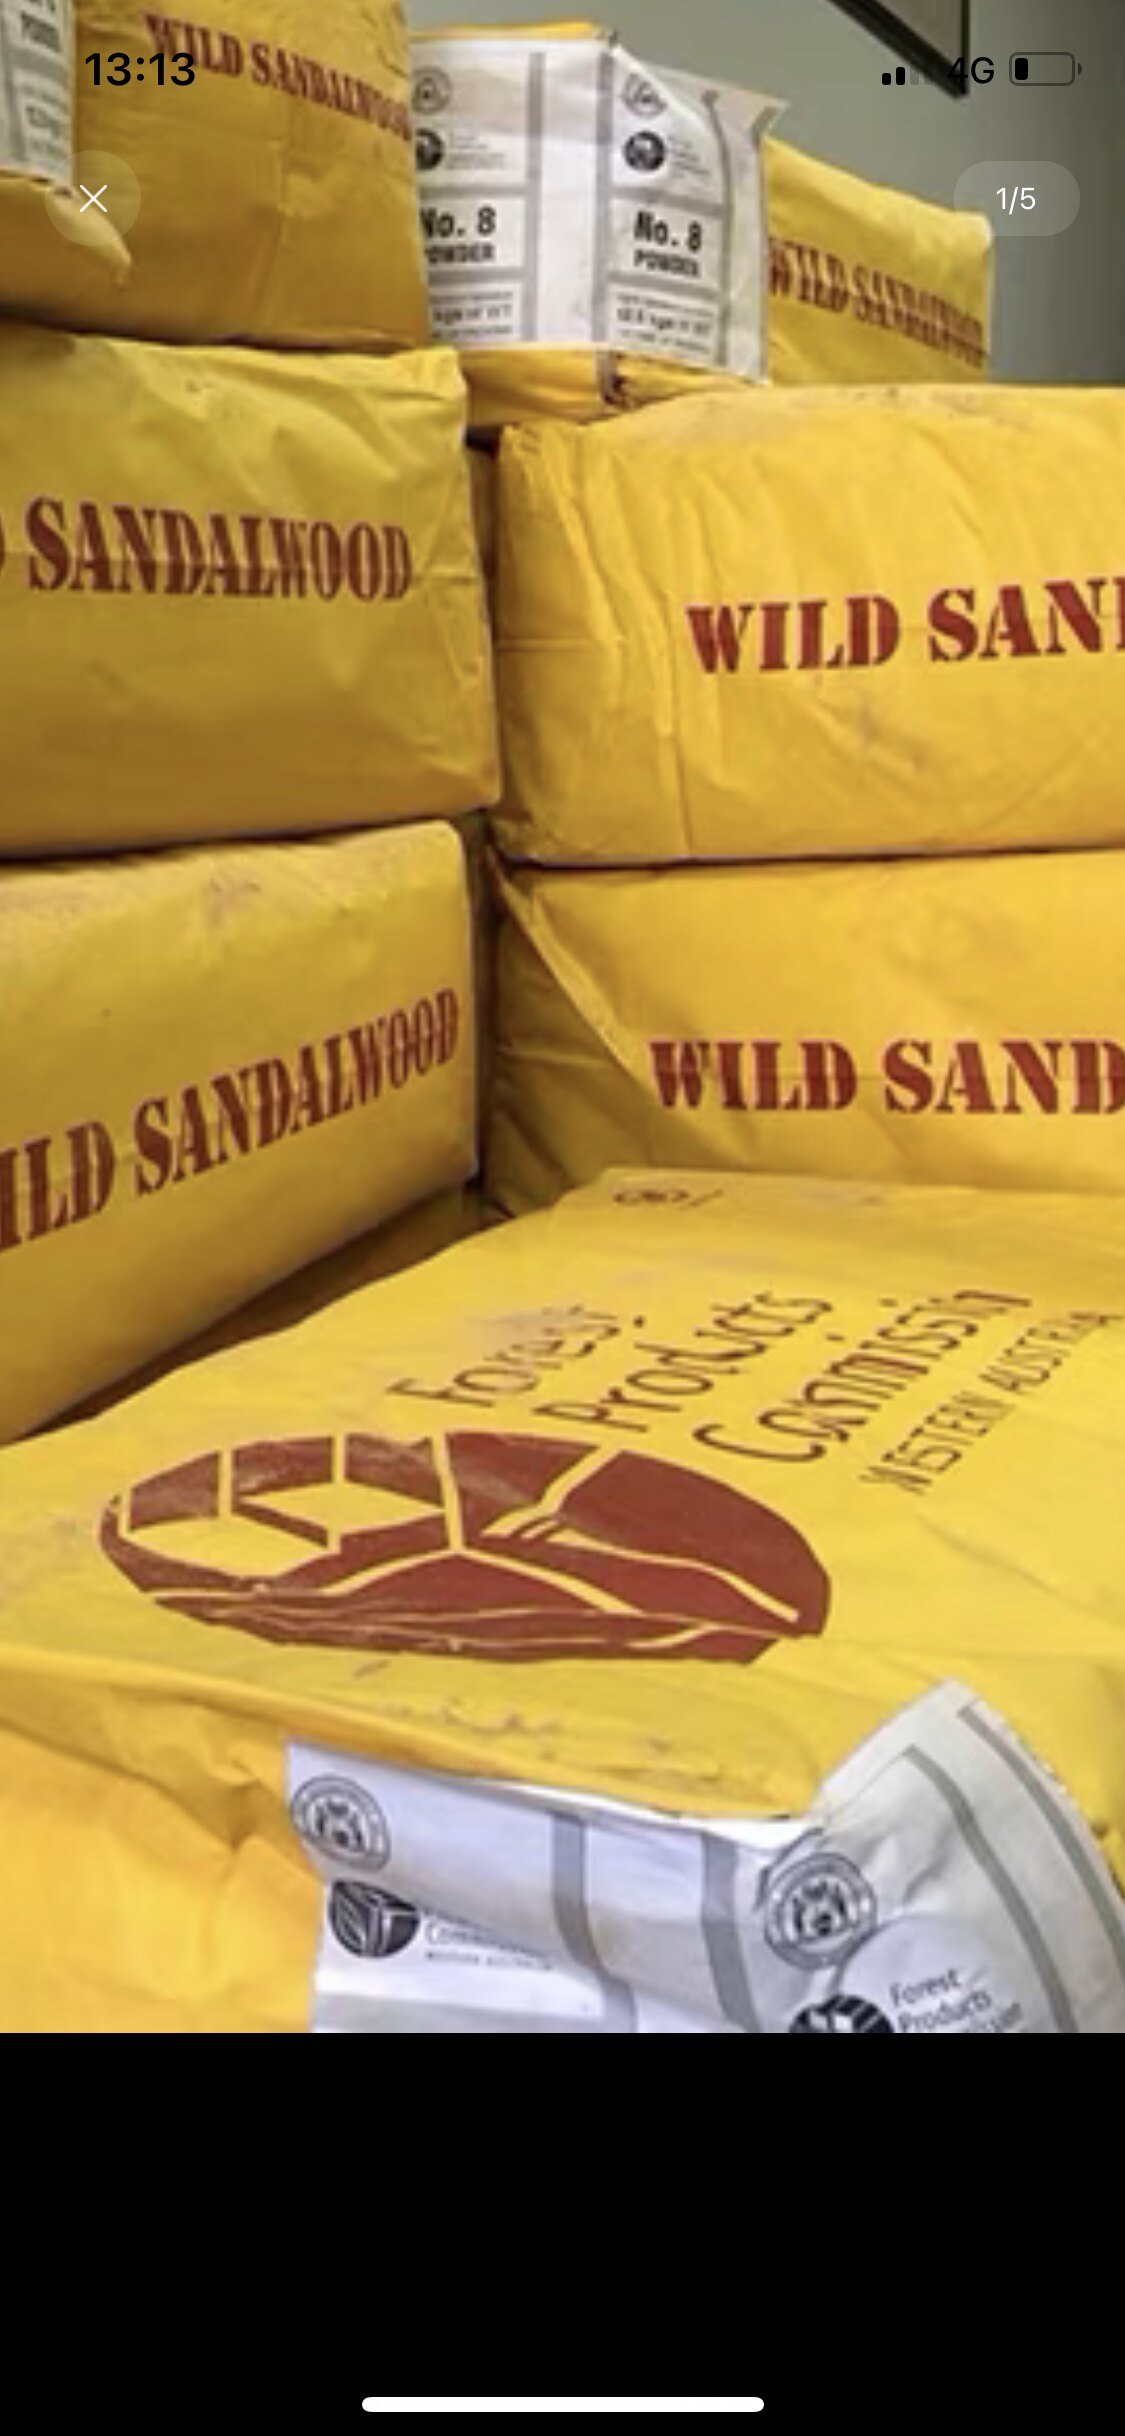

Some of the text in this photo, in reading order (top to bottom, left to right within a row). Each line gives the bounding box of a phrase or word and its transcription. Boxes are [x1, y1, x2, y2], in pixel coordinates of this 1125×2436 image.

[144, 13, 244, 77] WILD
[420, 206, 496, 238] No. 8
[634, 210, 702, 253] No. 8
[23, 496, 413, 602] SANDALWOOD
[686, 595, 901, 674] WILD
[132, 987, 460, 1196] SANDALWOOD
[648, 1040, 1125, 1114] WILD SAND
[532, 1291, 834, 1433] Products
[889, 1968, 961, 2008] Forest
